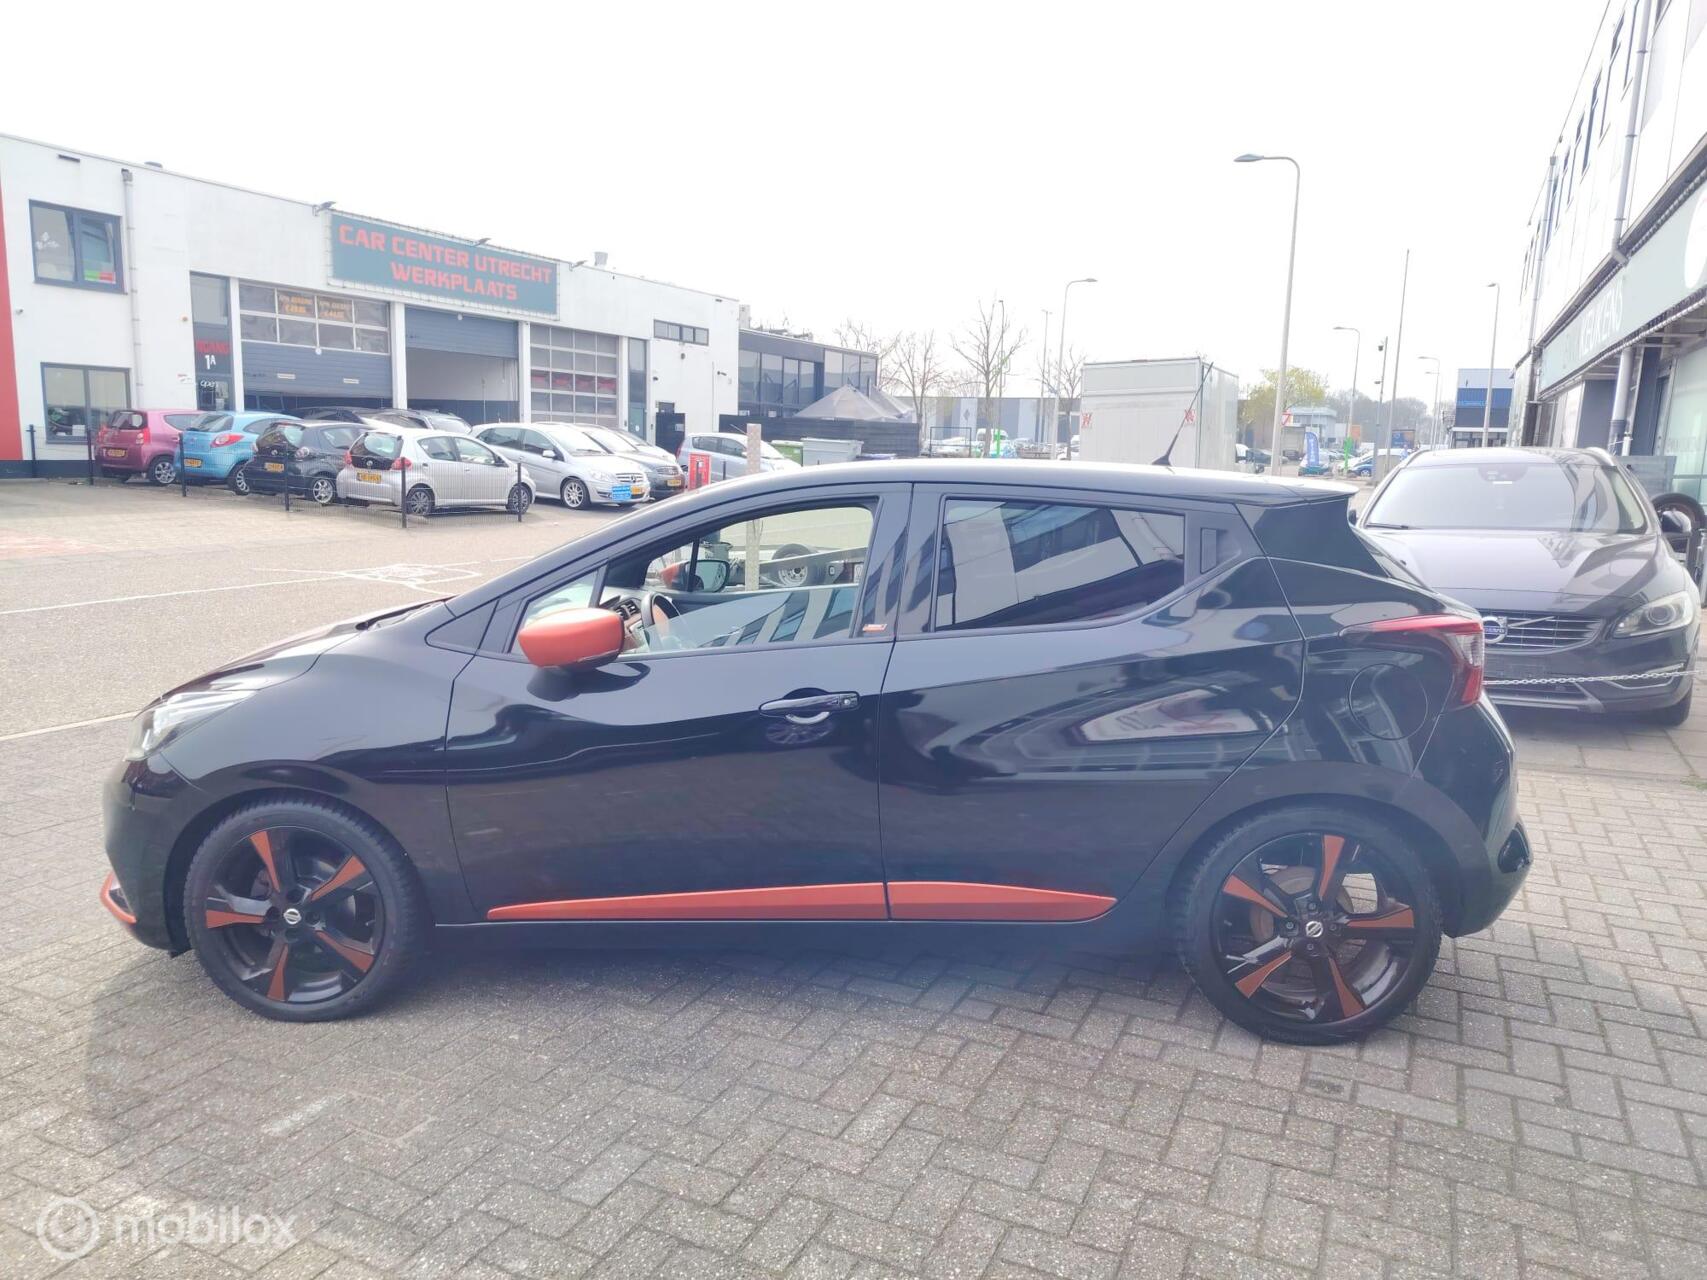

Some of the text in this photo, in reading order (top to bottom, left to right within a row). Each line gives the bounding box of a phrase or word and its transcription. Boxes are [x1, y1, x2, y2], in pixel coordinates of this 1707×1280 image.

[338, 224, 552, 284] CAR CENTER UTRECHT
[389, 261, 518, 301] WERKPLAATS
[204, 354, 217, 371] 1A
